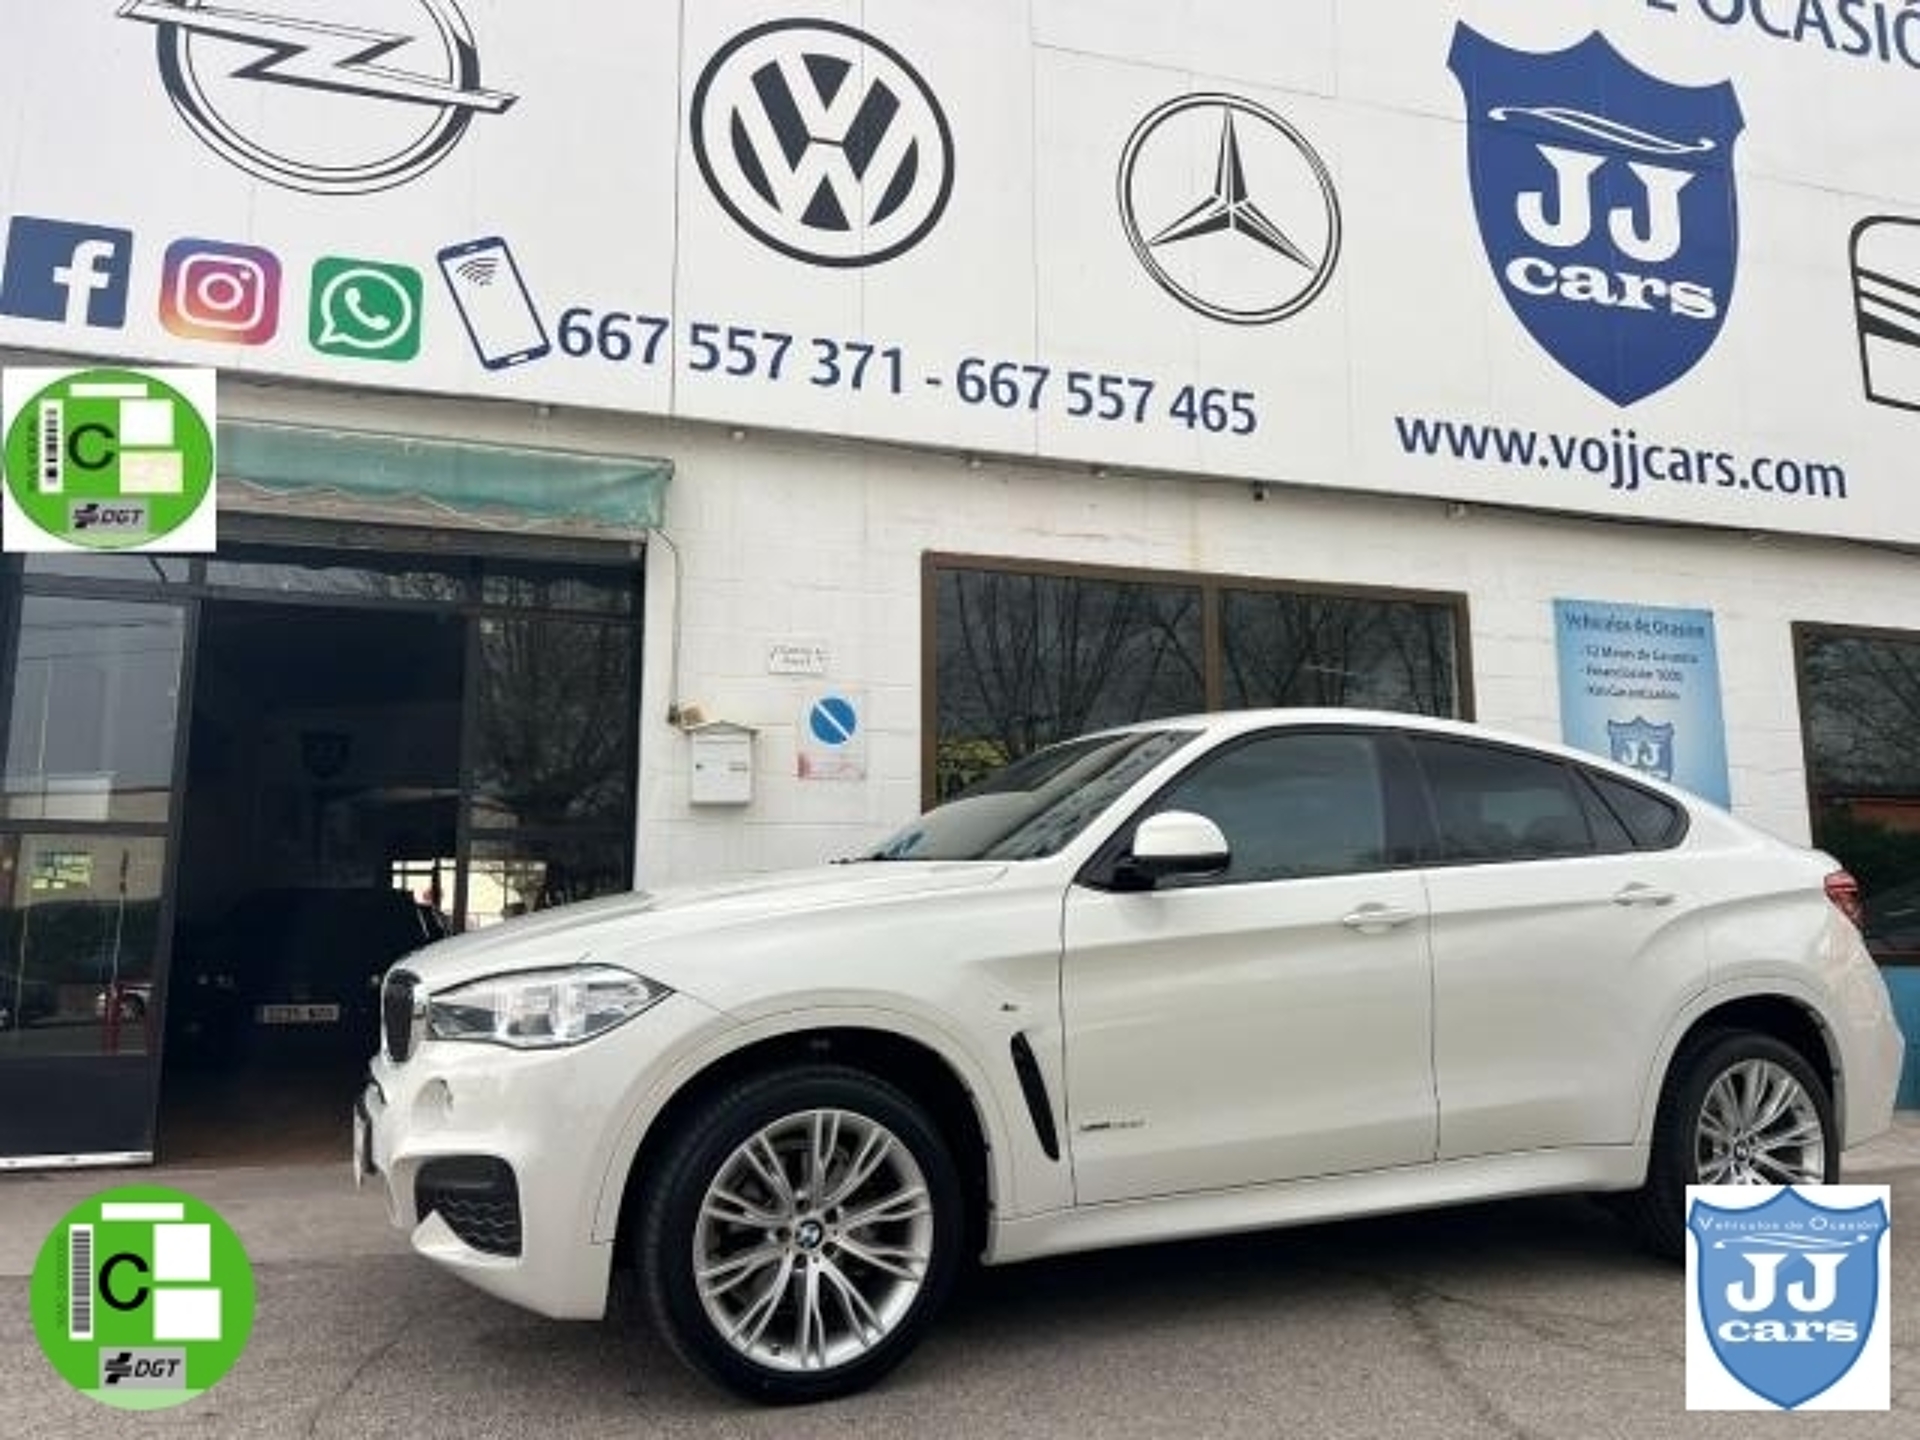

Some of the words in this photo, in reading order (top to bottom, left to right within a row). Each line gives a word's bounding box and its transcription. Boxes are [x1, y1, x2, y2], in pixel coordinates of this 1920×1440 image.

[1516, 143, 1696, 263] JJ
[1505, 256, 1717, 321] cars
[556, 306, 670, 366] 667
[688, 321, 793, 381] 557
[809, 336, 904, 395] 371
[955, 356, 1051, 411] 667
[1065, 371, 1155, 424] 557
[1168, 385, 1258, 437] 465
[1395, 415, 1848, 499] www.vojjcars.com
[1621, 740, 1662, 767] JJ
